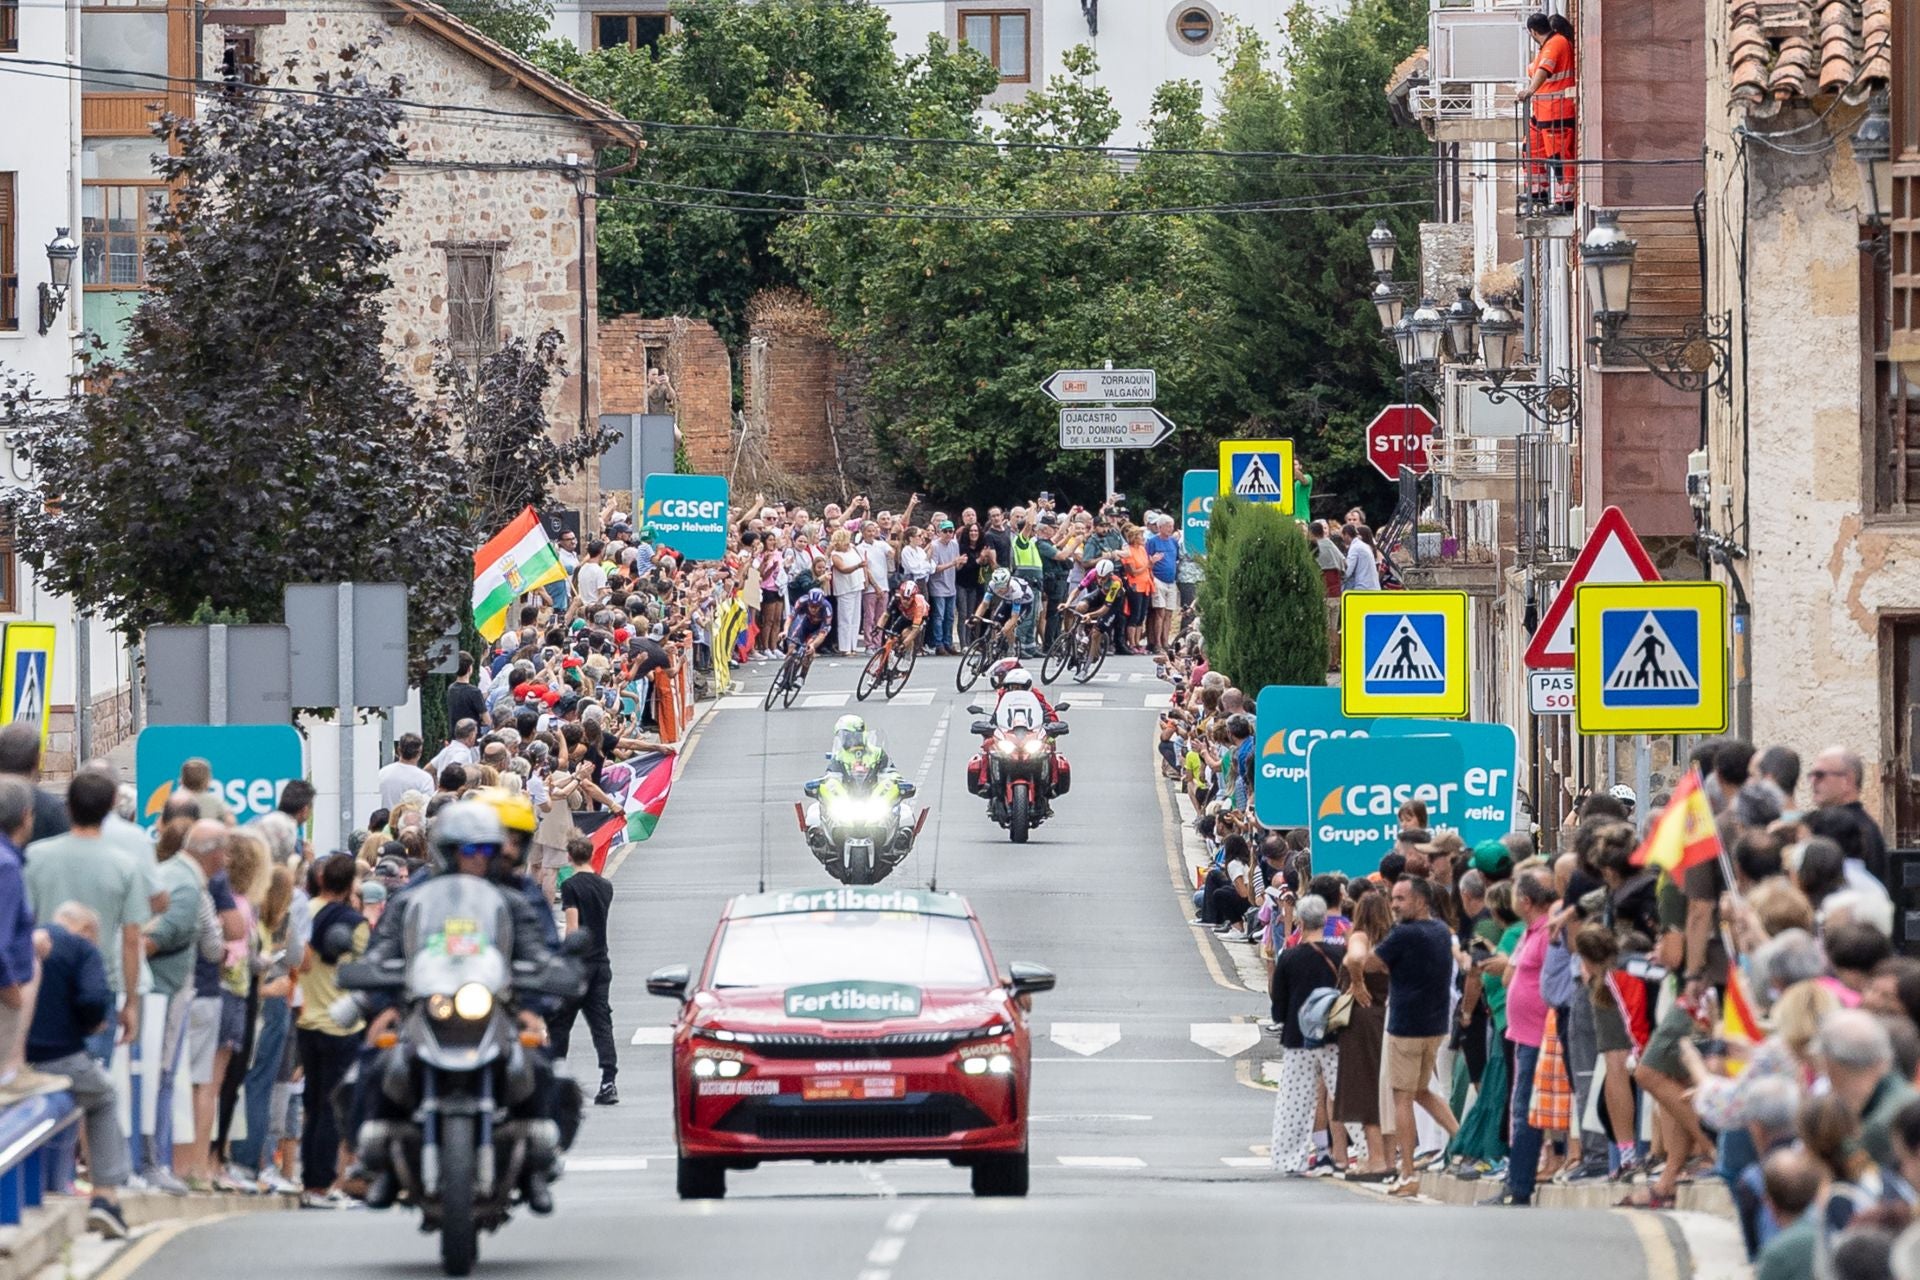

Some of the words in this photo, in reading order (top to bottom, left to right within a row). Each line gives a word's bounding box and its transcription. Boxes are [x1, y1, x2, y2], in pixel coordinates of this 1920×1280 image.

[1104, 386, 1150, 397] VALGAÑÓN
[1065, 413, 1117, 423] OJACASTRO
[1088, 425, 1128, 435] DOMINGO
[1070, 436, 1079, 444] DE
[1082, 436, 1091, 444] LA
[1093, 436, 1123, 444] CALZADA
[663, 500, 725, 519] caser
[682, 522, 724, 533] Helvetia
[1346, 783, 1458, 816] caser
[1318, 825, 1380, 846] Grupo
[777, 889, 918, 912] Fertiberia
[789, 987, 915, 1013] Fertiberia
